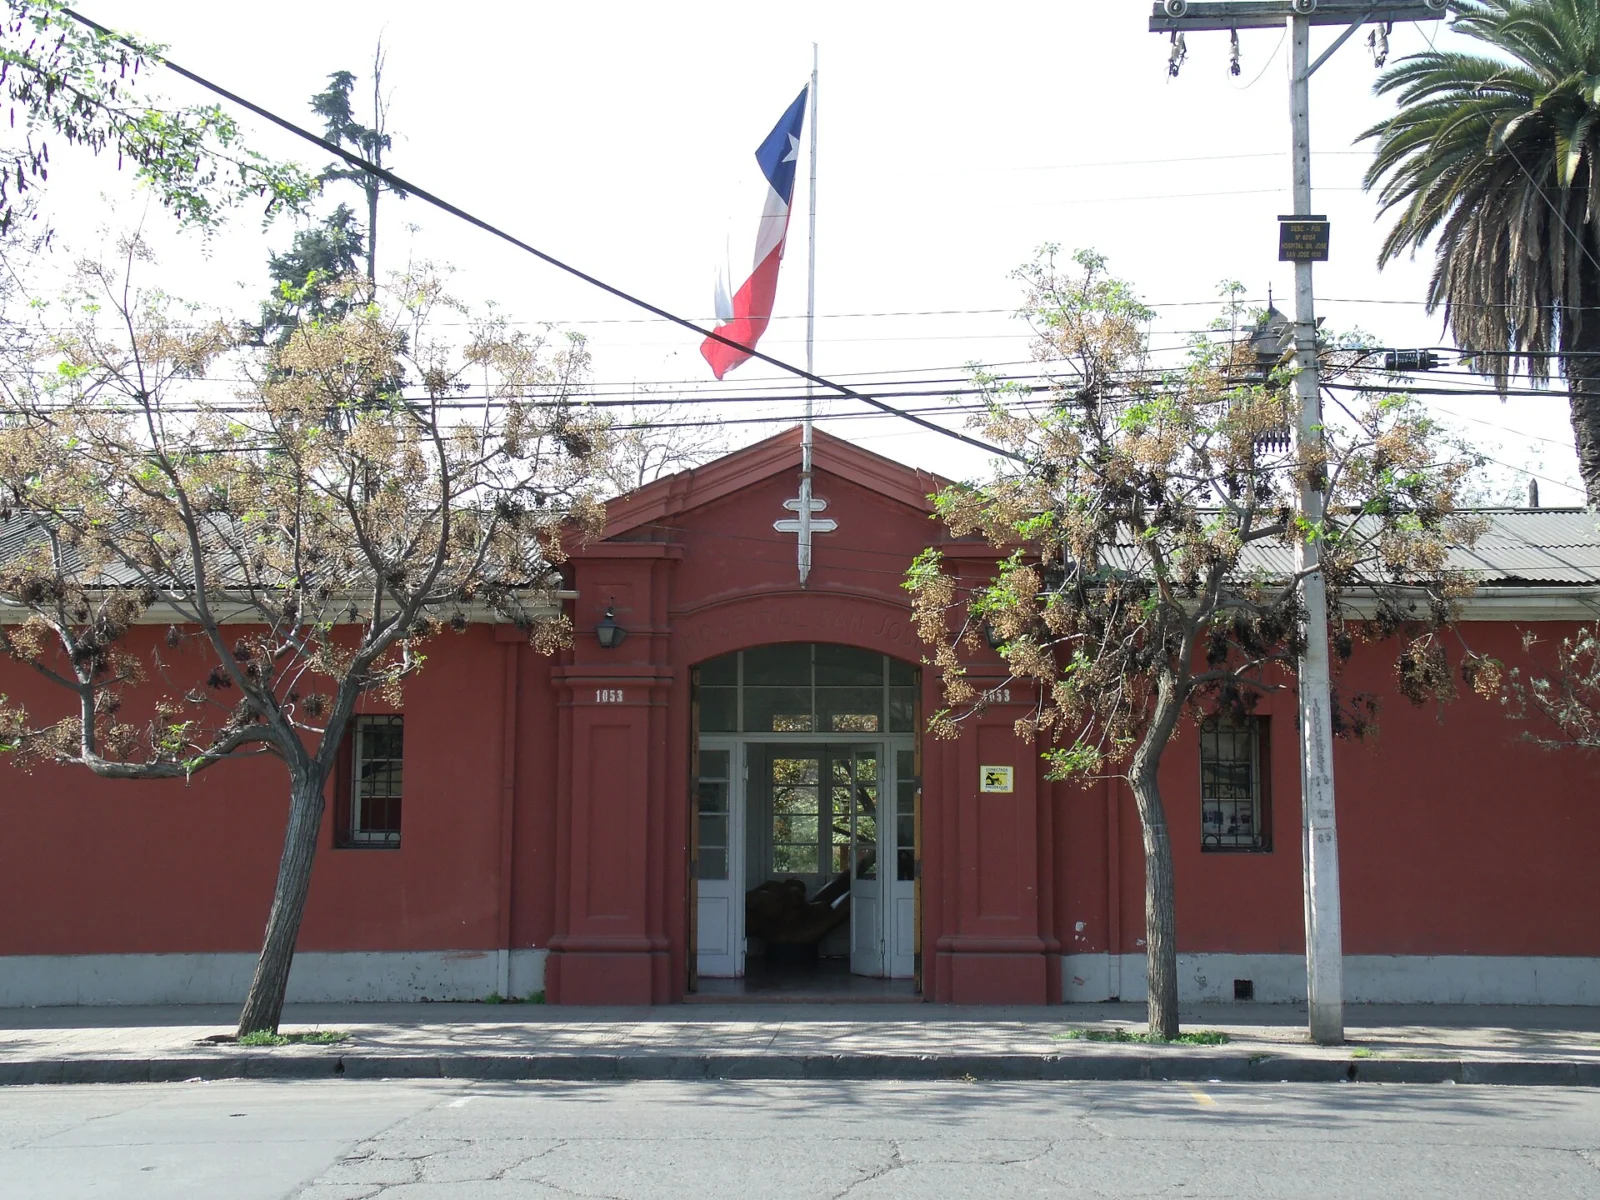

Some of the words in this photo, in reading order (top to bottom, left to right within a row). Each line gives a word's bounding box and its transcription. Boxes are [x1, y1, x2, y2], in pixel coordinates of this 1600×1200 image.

[680, 608, 808, 652] HOSPITAL
[820, 608, 865, 631] SAN
[596, 689, 623, 703] 1053
